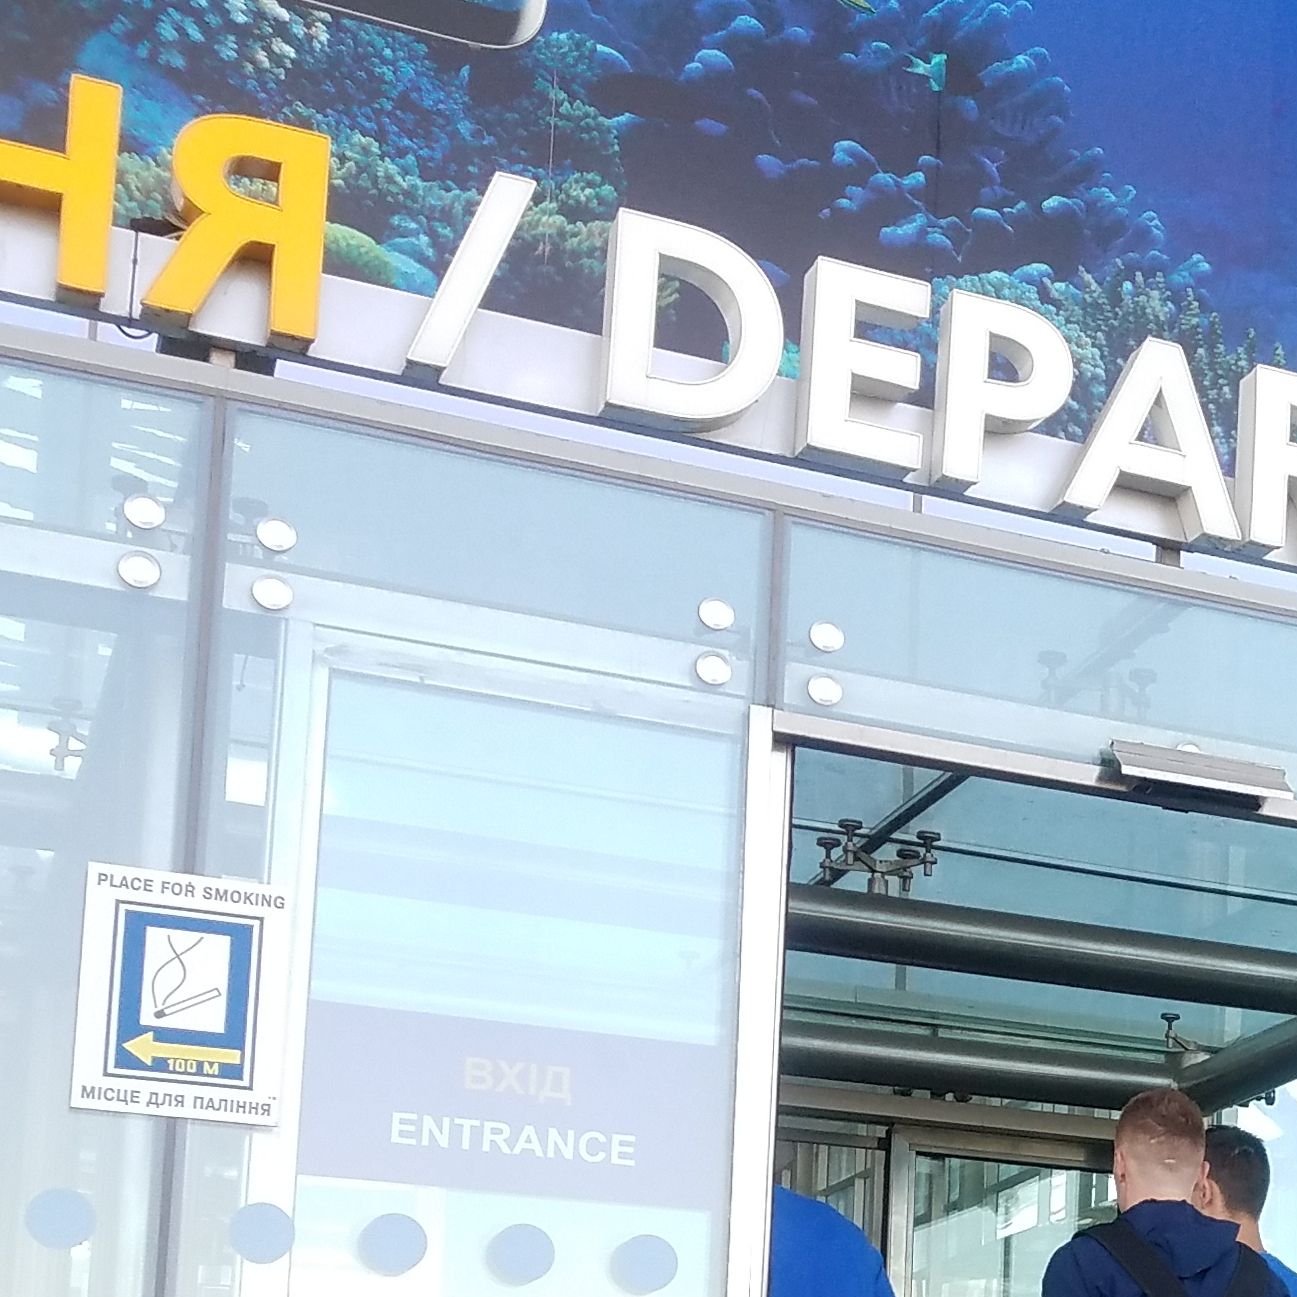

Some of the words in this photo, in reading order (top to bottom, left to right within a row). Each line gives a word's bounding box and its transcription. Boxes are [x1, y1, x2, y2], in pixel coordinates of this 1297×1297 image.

[97, 873, 154, 892] PLACE
[160, 881, 196, 897] FOR
[203, 886, 286, 909] SMOKING
[167, 1058, 197, 1073] 100
[465, 1056, 572, 1106] ВХІД
[81, 1085, 141, 1105] МІСЦЕ
[146, 1092, 185, 1108] ДЛЯ
[193, 1096, 272, 1117] ПАЛІННЯ
[390, 1111, 636, 1166] ENTRANCE
